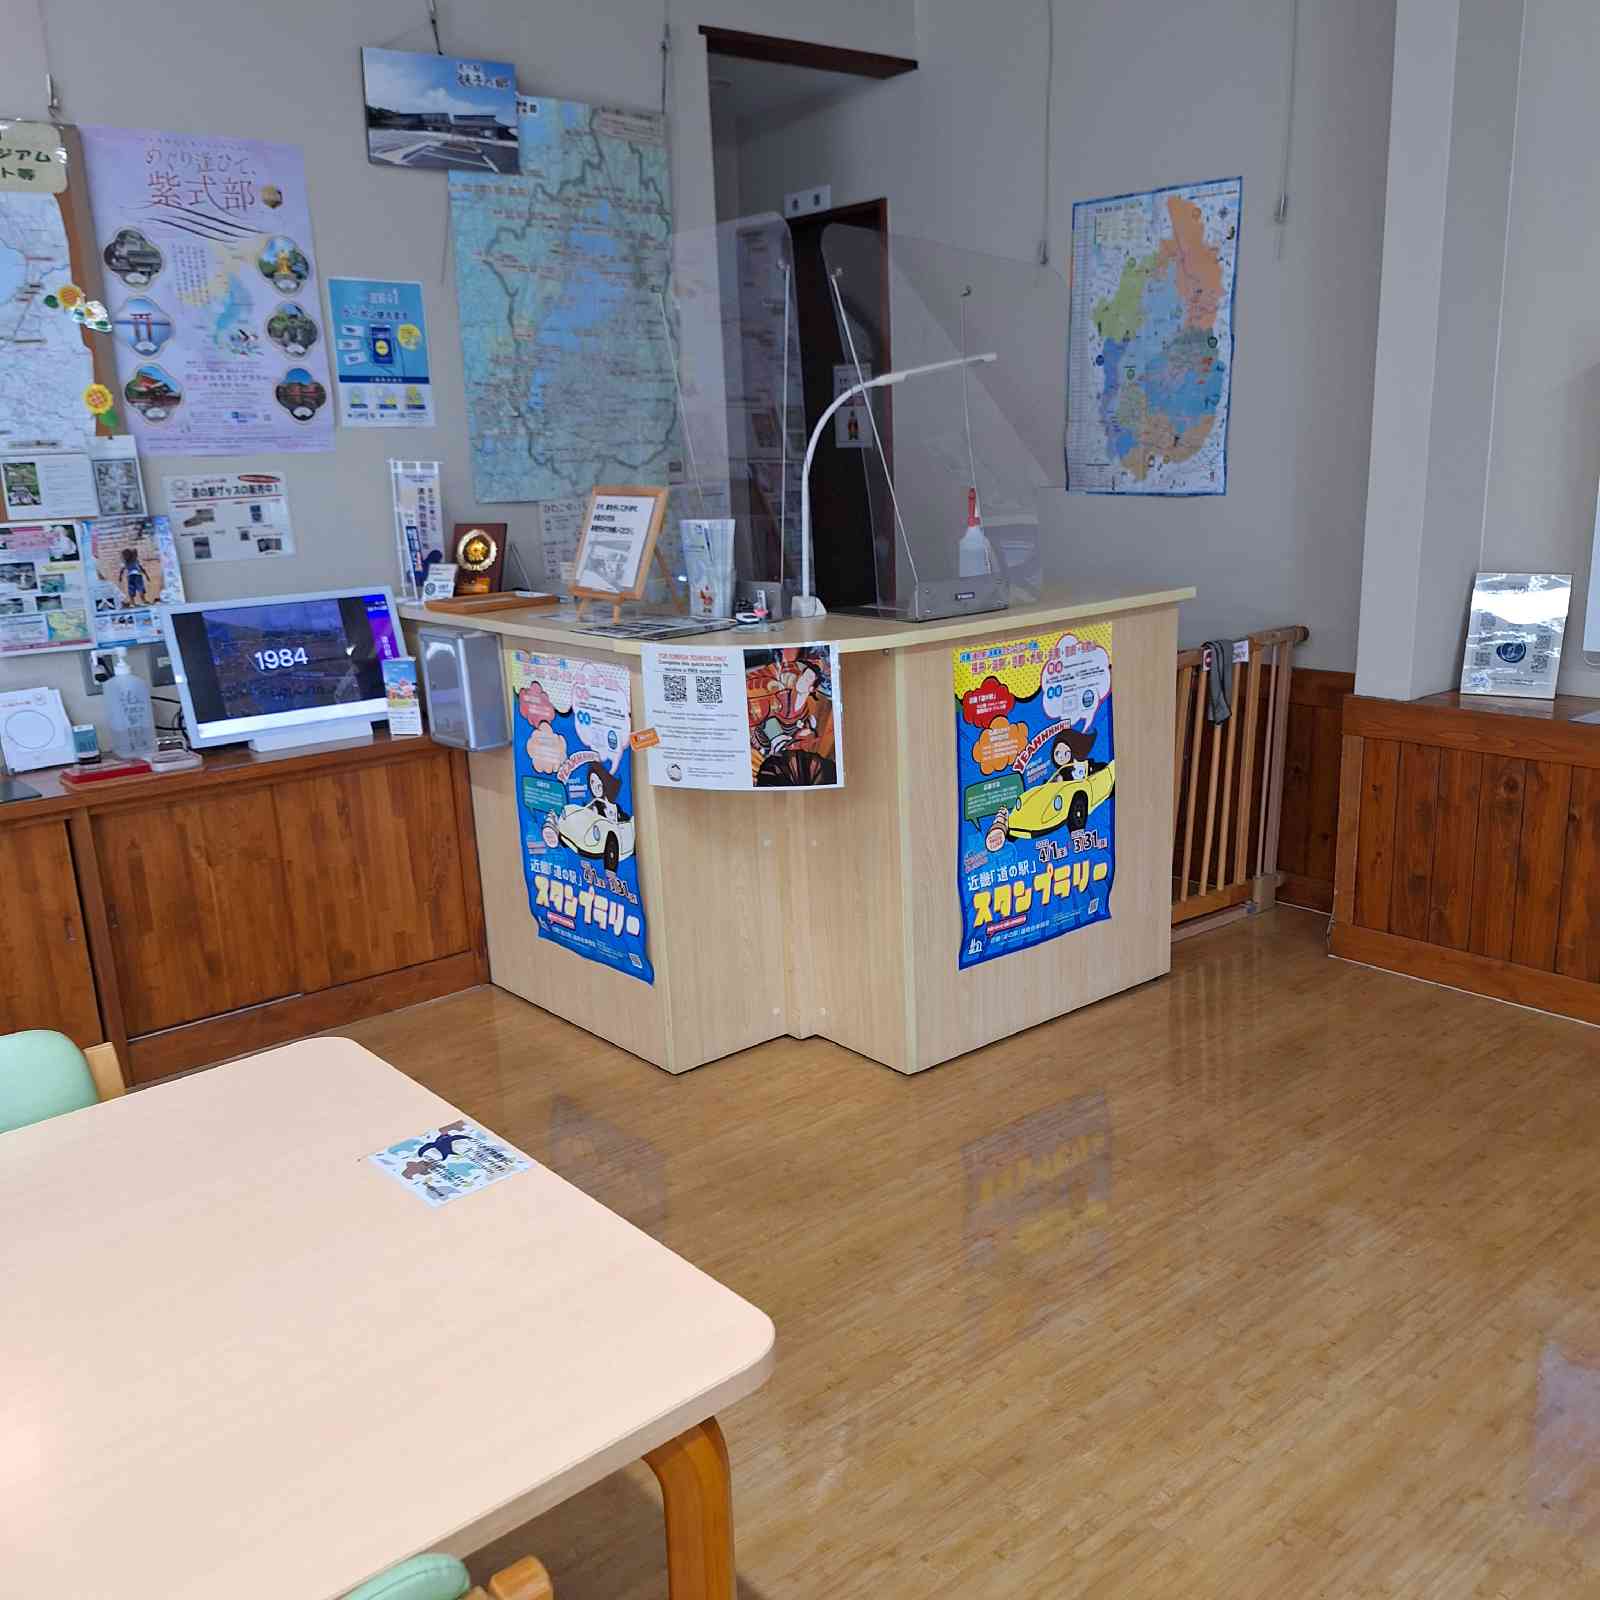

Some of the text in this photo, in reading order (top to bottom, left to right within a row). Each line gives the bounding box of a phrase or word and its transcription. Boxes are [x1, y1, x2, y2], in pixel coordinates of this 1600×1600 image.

[147, 171, 256, 214] 紫式部
[254, 647, 309, 671] 1984
[967, 860, 1037, 891] 近畿「道の駅」
[973, 860, 1108, 928] スタンプラリー
[534, 875, 640, 936] スタンプラリー
